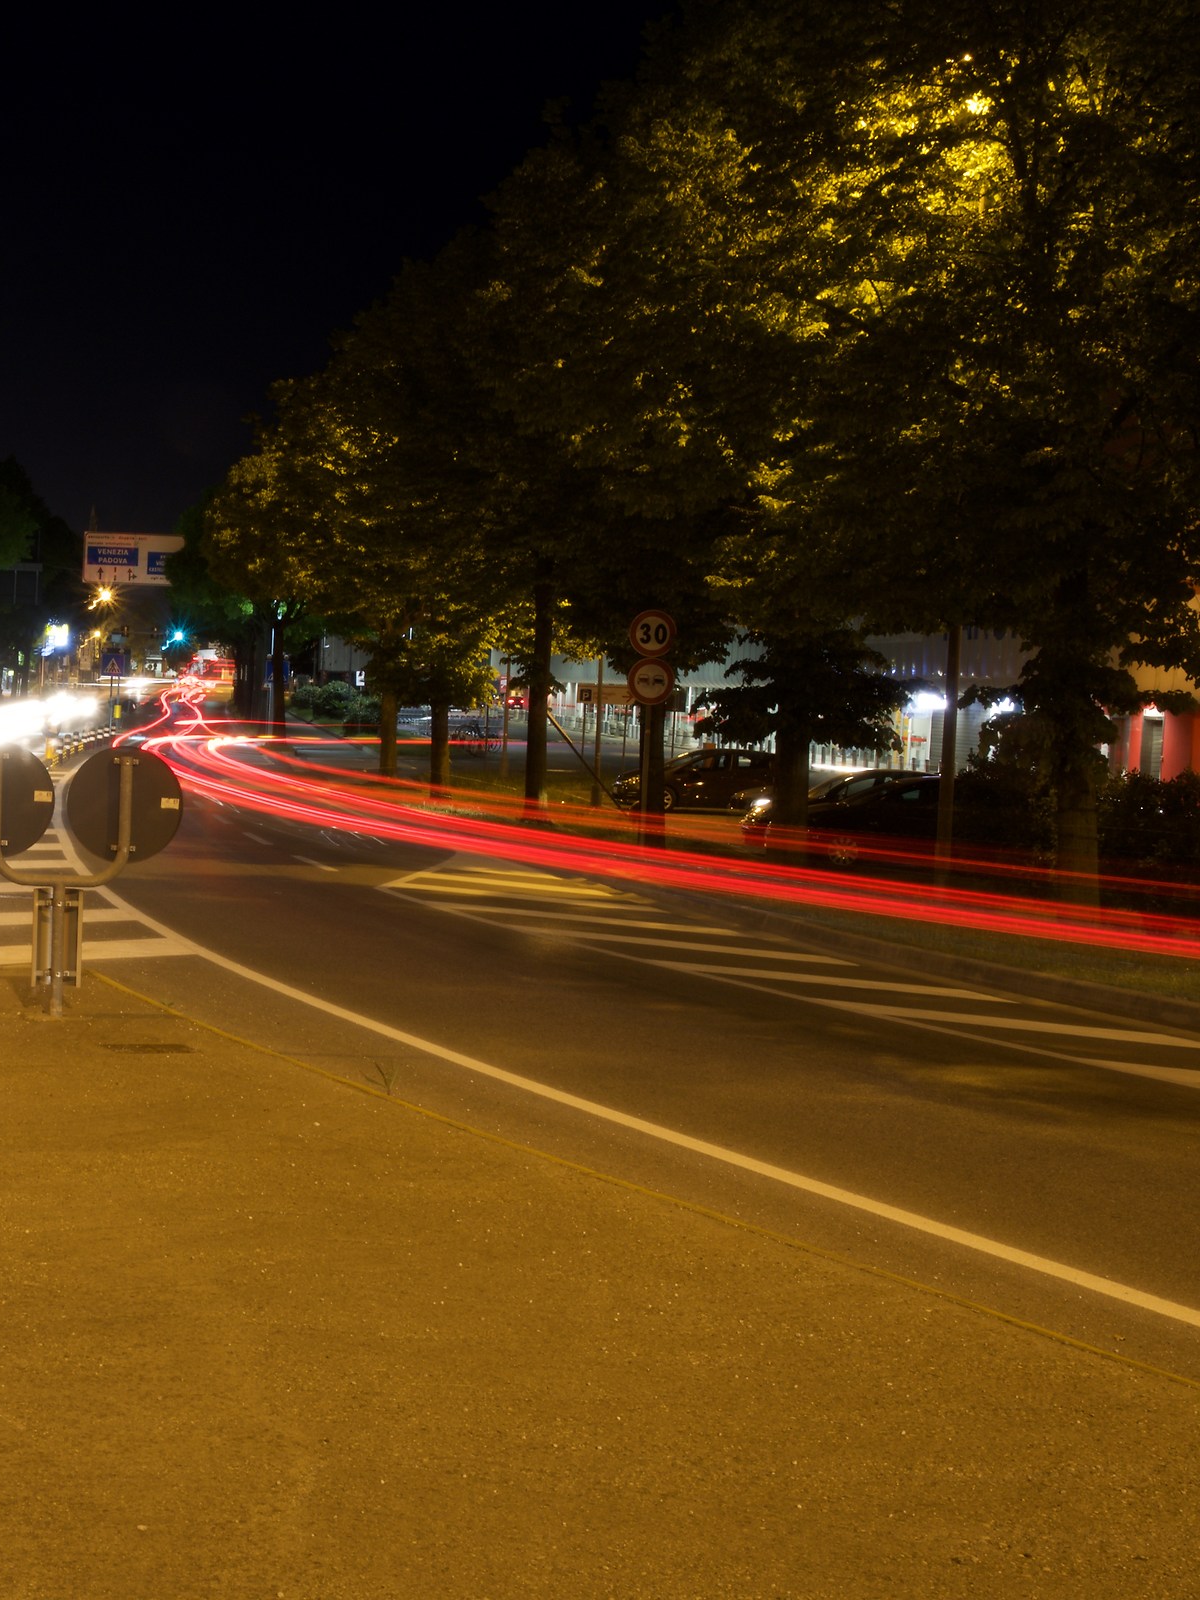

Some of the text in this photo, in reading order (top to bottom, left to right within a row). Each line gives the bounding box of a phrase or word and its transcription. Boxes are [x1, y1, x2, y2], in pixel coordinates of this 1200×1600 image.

[97, 548, 129, 556] VENEZIA
[98, 556, 128, 564] PADOVA
[639, 623, 668, 645] 30
